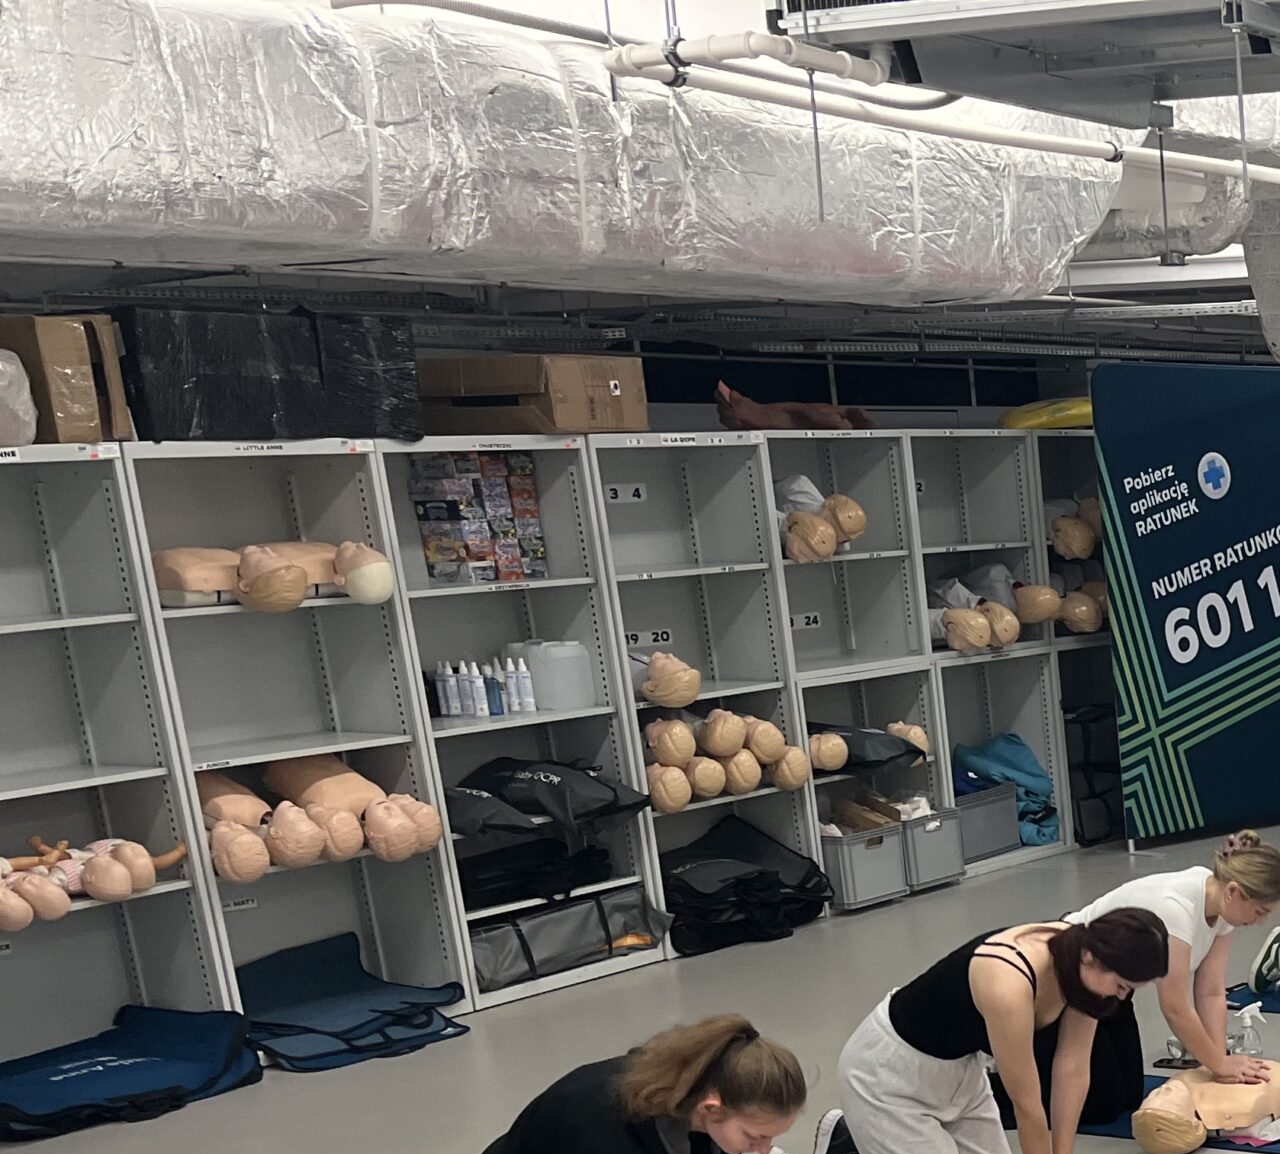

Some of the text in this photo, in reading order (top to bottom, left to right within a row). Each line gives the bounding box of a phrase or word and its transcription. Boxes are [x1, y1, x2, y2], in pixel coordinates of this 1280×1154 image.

[608, 487, 642, 500] 3 4
[1123, 463, 1175, 494] Pobierz
[1130, 480, 1189, 515] aplikację
[1135, 499, 1199, 537] RATUNEK
[1152, 549, 1214, 600] NUMER
[651, 630, 670, 643] 20
[804, 615, 819, 626] 24
[1164, 578, 1255, 665] 601
